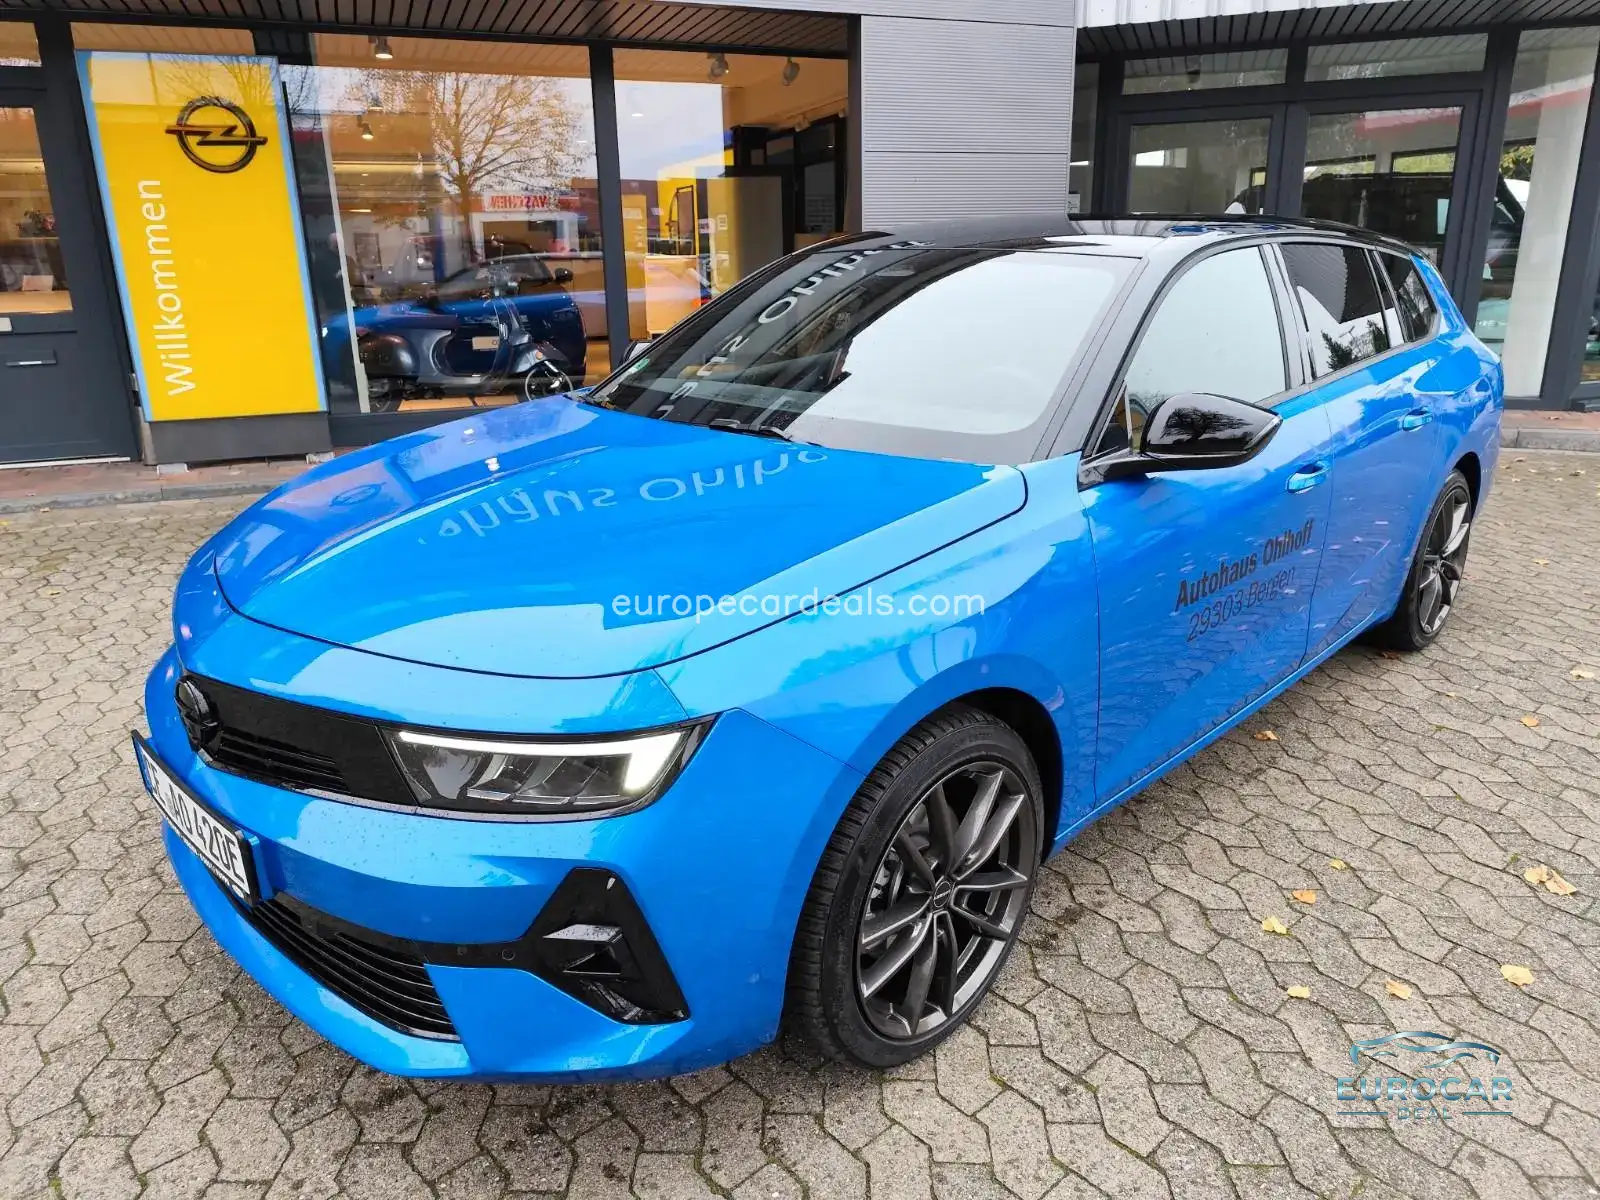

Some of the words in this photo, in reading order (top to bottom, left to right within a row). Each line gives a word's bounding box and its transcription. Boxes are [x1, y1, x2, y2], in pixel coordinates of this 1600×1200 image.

[137, 180, 196, 396] Willkommen
[1174, 552, 1258, 612] Autohaus
[1262, 518, 1315, 566] Ohlhoff
[1187, 590, 1244, 642] 29303
[1247, 566, 1296, 608] Bergen
